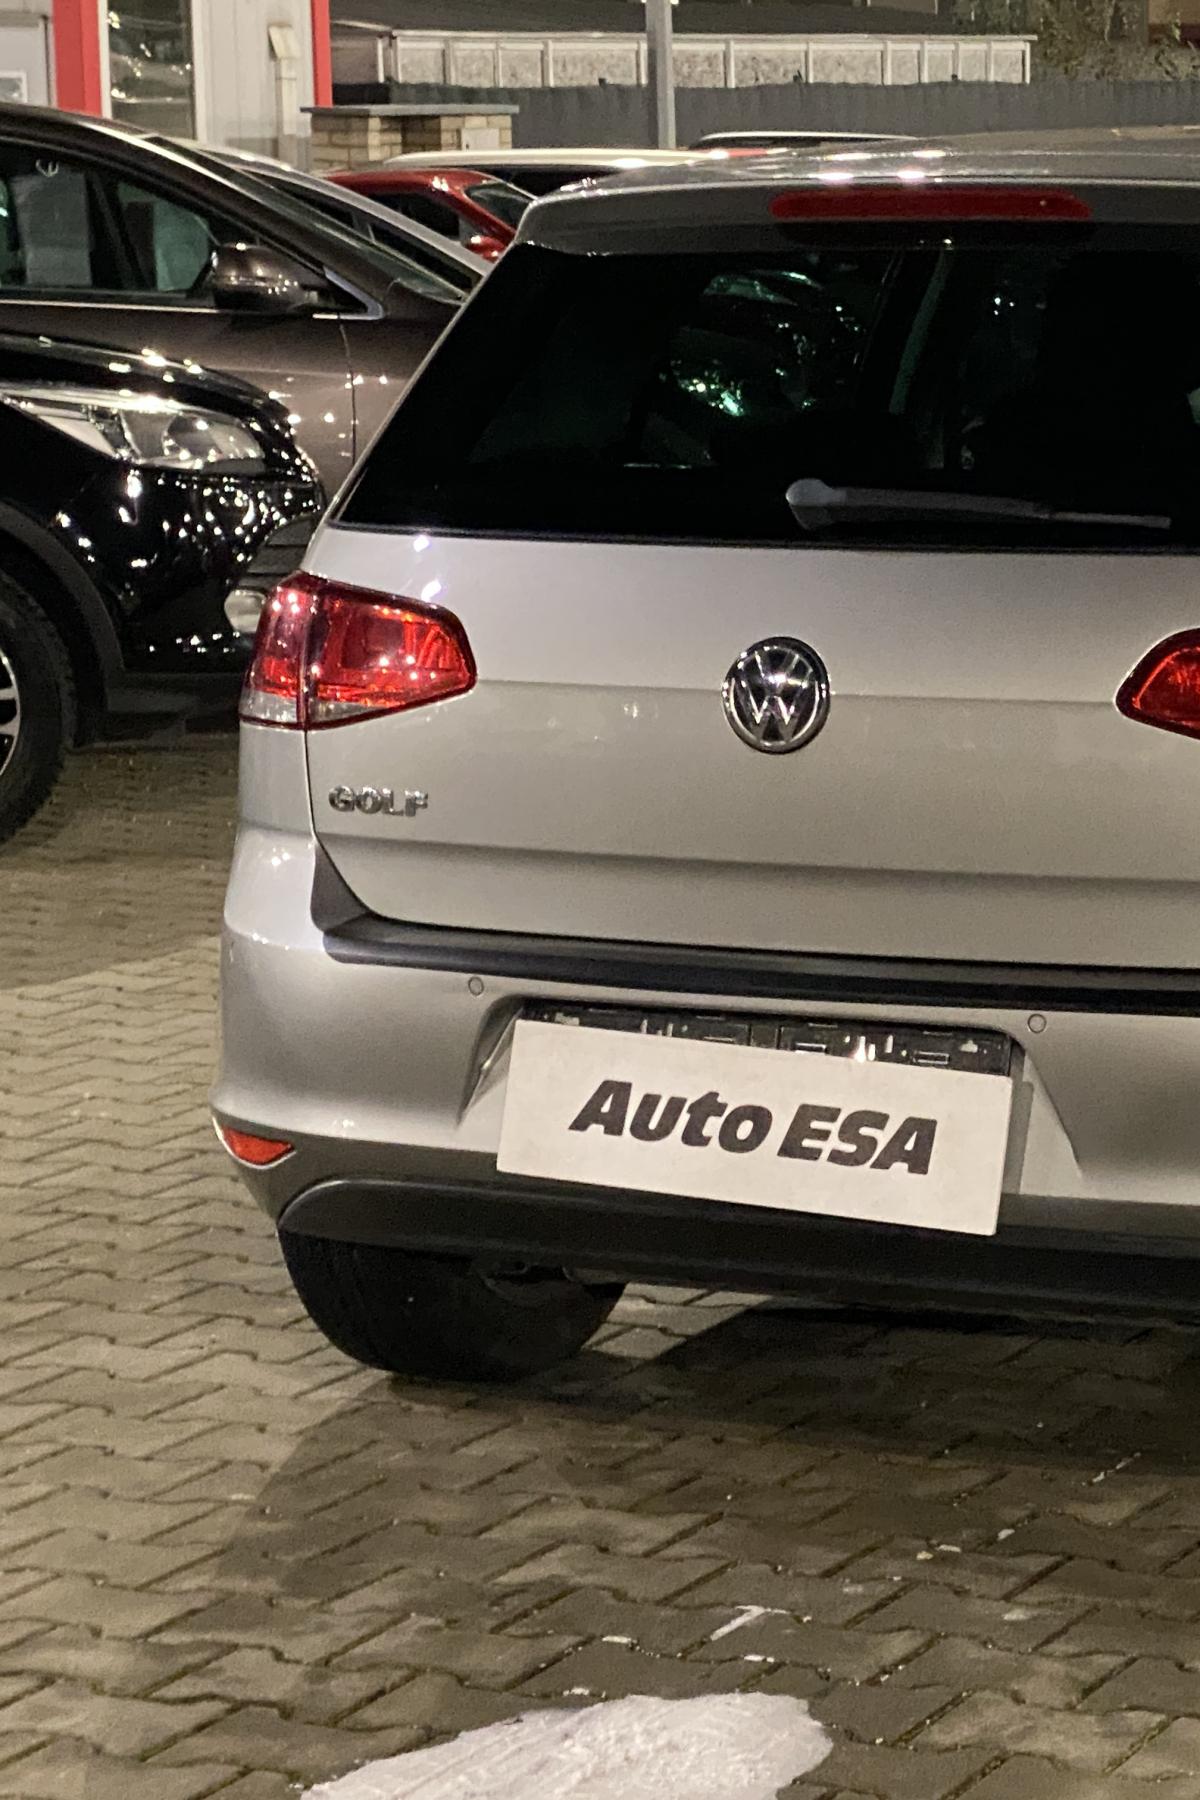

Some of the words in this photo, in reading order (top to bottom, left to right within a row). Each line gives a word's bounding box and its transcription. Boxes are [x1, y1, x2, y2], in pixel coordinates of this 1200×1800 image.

[328, 785, 429, 817] GOLF
[568, 1079, 773, 1154] Auto
[776, 1103, 938, 1175] ESA
